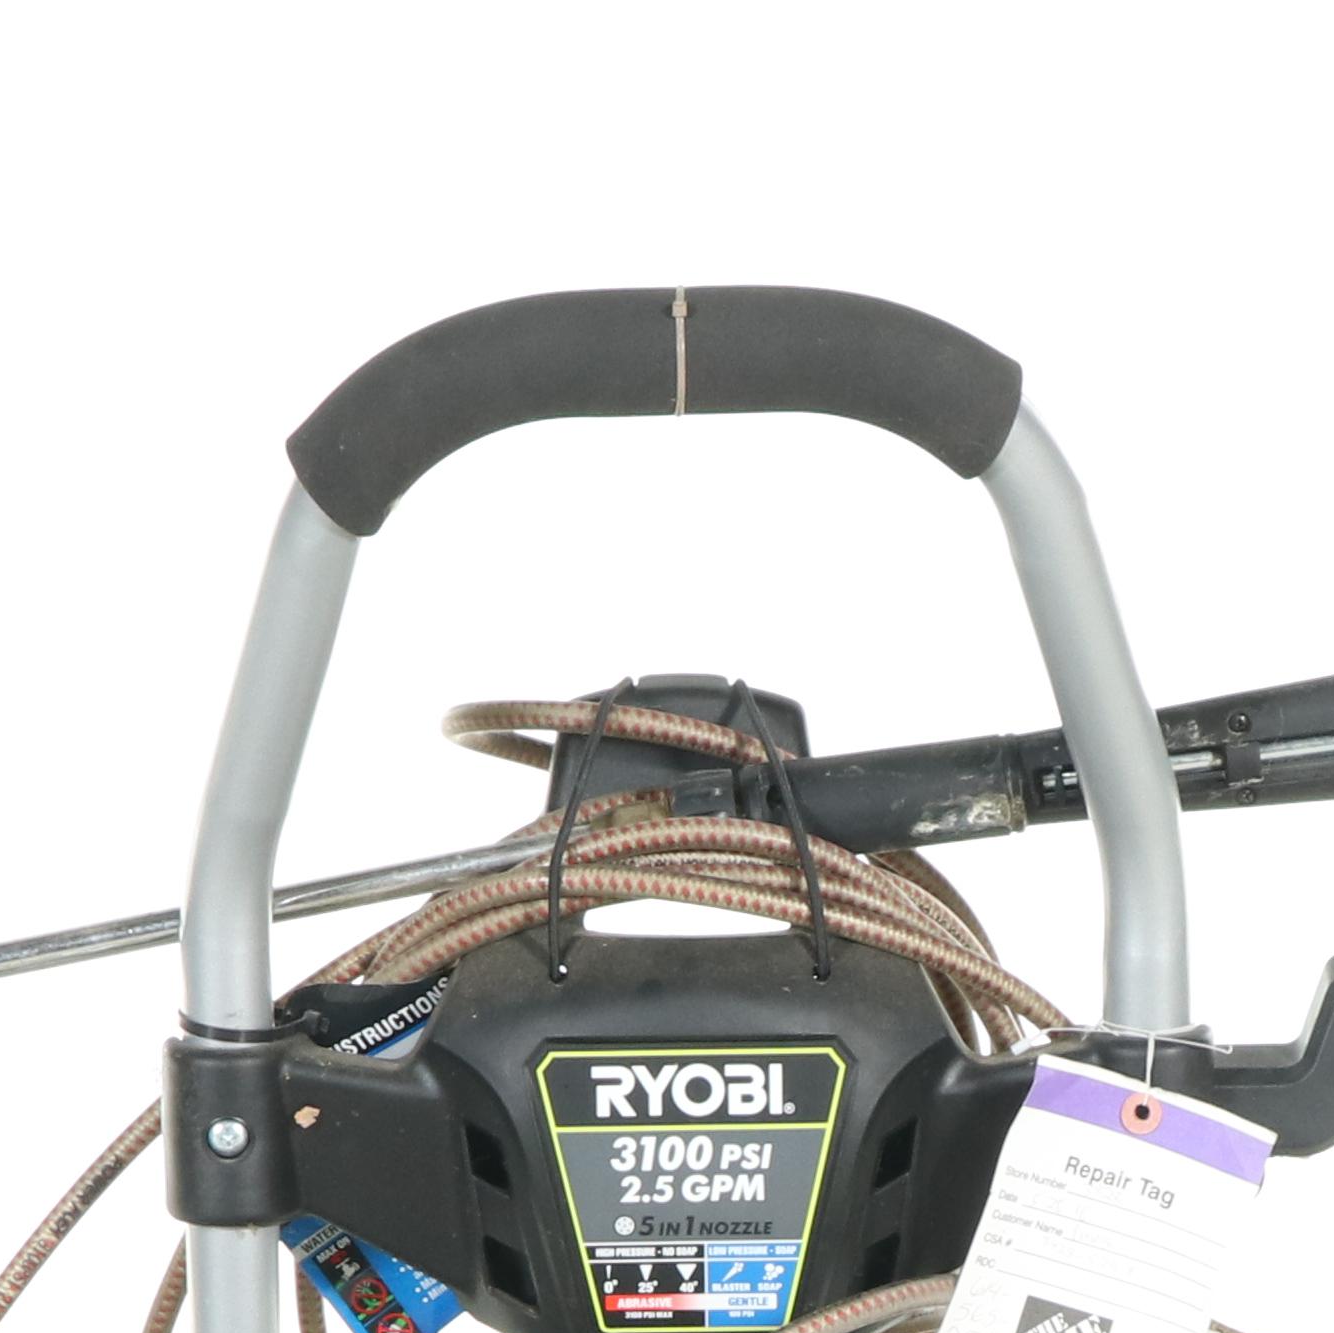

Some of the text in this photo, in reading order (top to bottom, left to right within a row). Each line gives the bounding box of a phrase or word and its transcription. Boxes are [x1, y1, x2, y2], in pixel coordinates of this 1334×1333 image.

[330, 976, 450, 1056] NSTRUCTIONS
[590, 1063, 783, 1118] RYOBI
[610, 1135, 773, 1172] 3100 PSI
[1005, 1165, 1067, 1190] Store Number
[1064, 1156, 1133, 1190] Repair
[1139, 1177, 1176, 1210] Tag
[620, 1174, 766, 1203] 2.5 GPM
[998, 1189, 1018, 1203] Date
[639, 1216, 773, 1236] 5 IN 1 NOZZLE
[991, 1209, 1034, 1229] Customer
[1035, 1220, 1064, 1237] Name
[300, 1223, 340, 1255] WATER
[983, 1232, 1003, 1247] CSA
[595, 1246, 698, 1257] HIGH PRESSURE NO SOAP
[728, 1245, 768, 1256] PRESSURE
[775, 1245, 796, 1255] SOAP
[712, 1283, 751, 1292] BLASTER
[758, 1283, 782, 1292] SOAP
[617, 1298, 673, 1309] ABRASIVE
[728, 1297, 768, 1306] GENTLE
